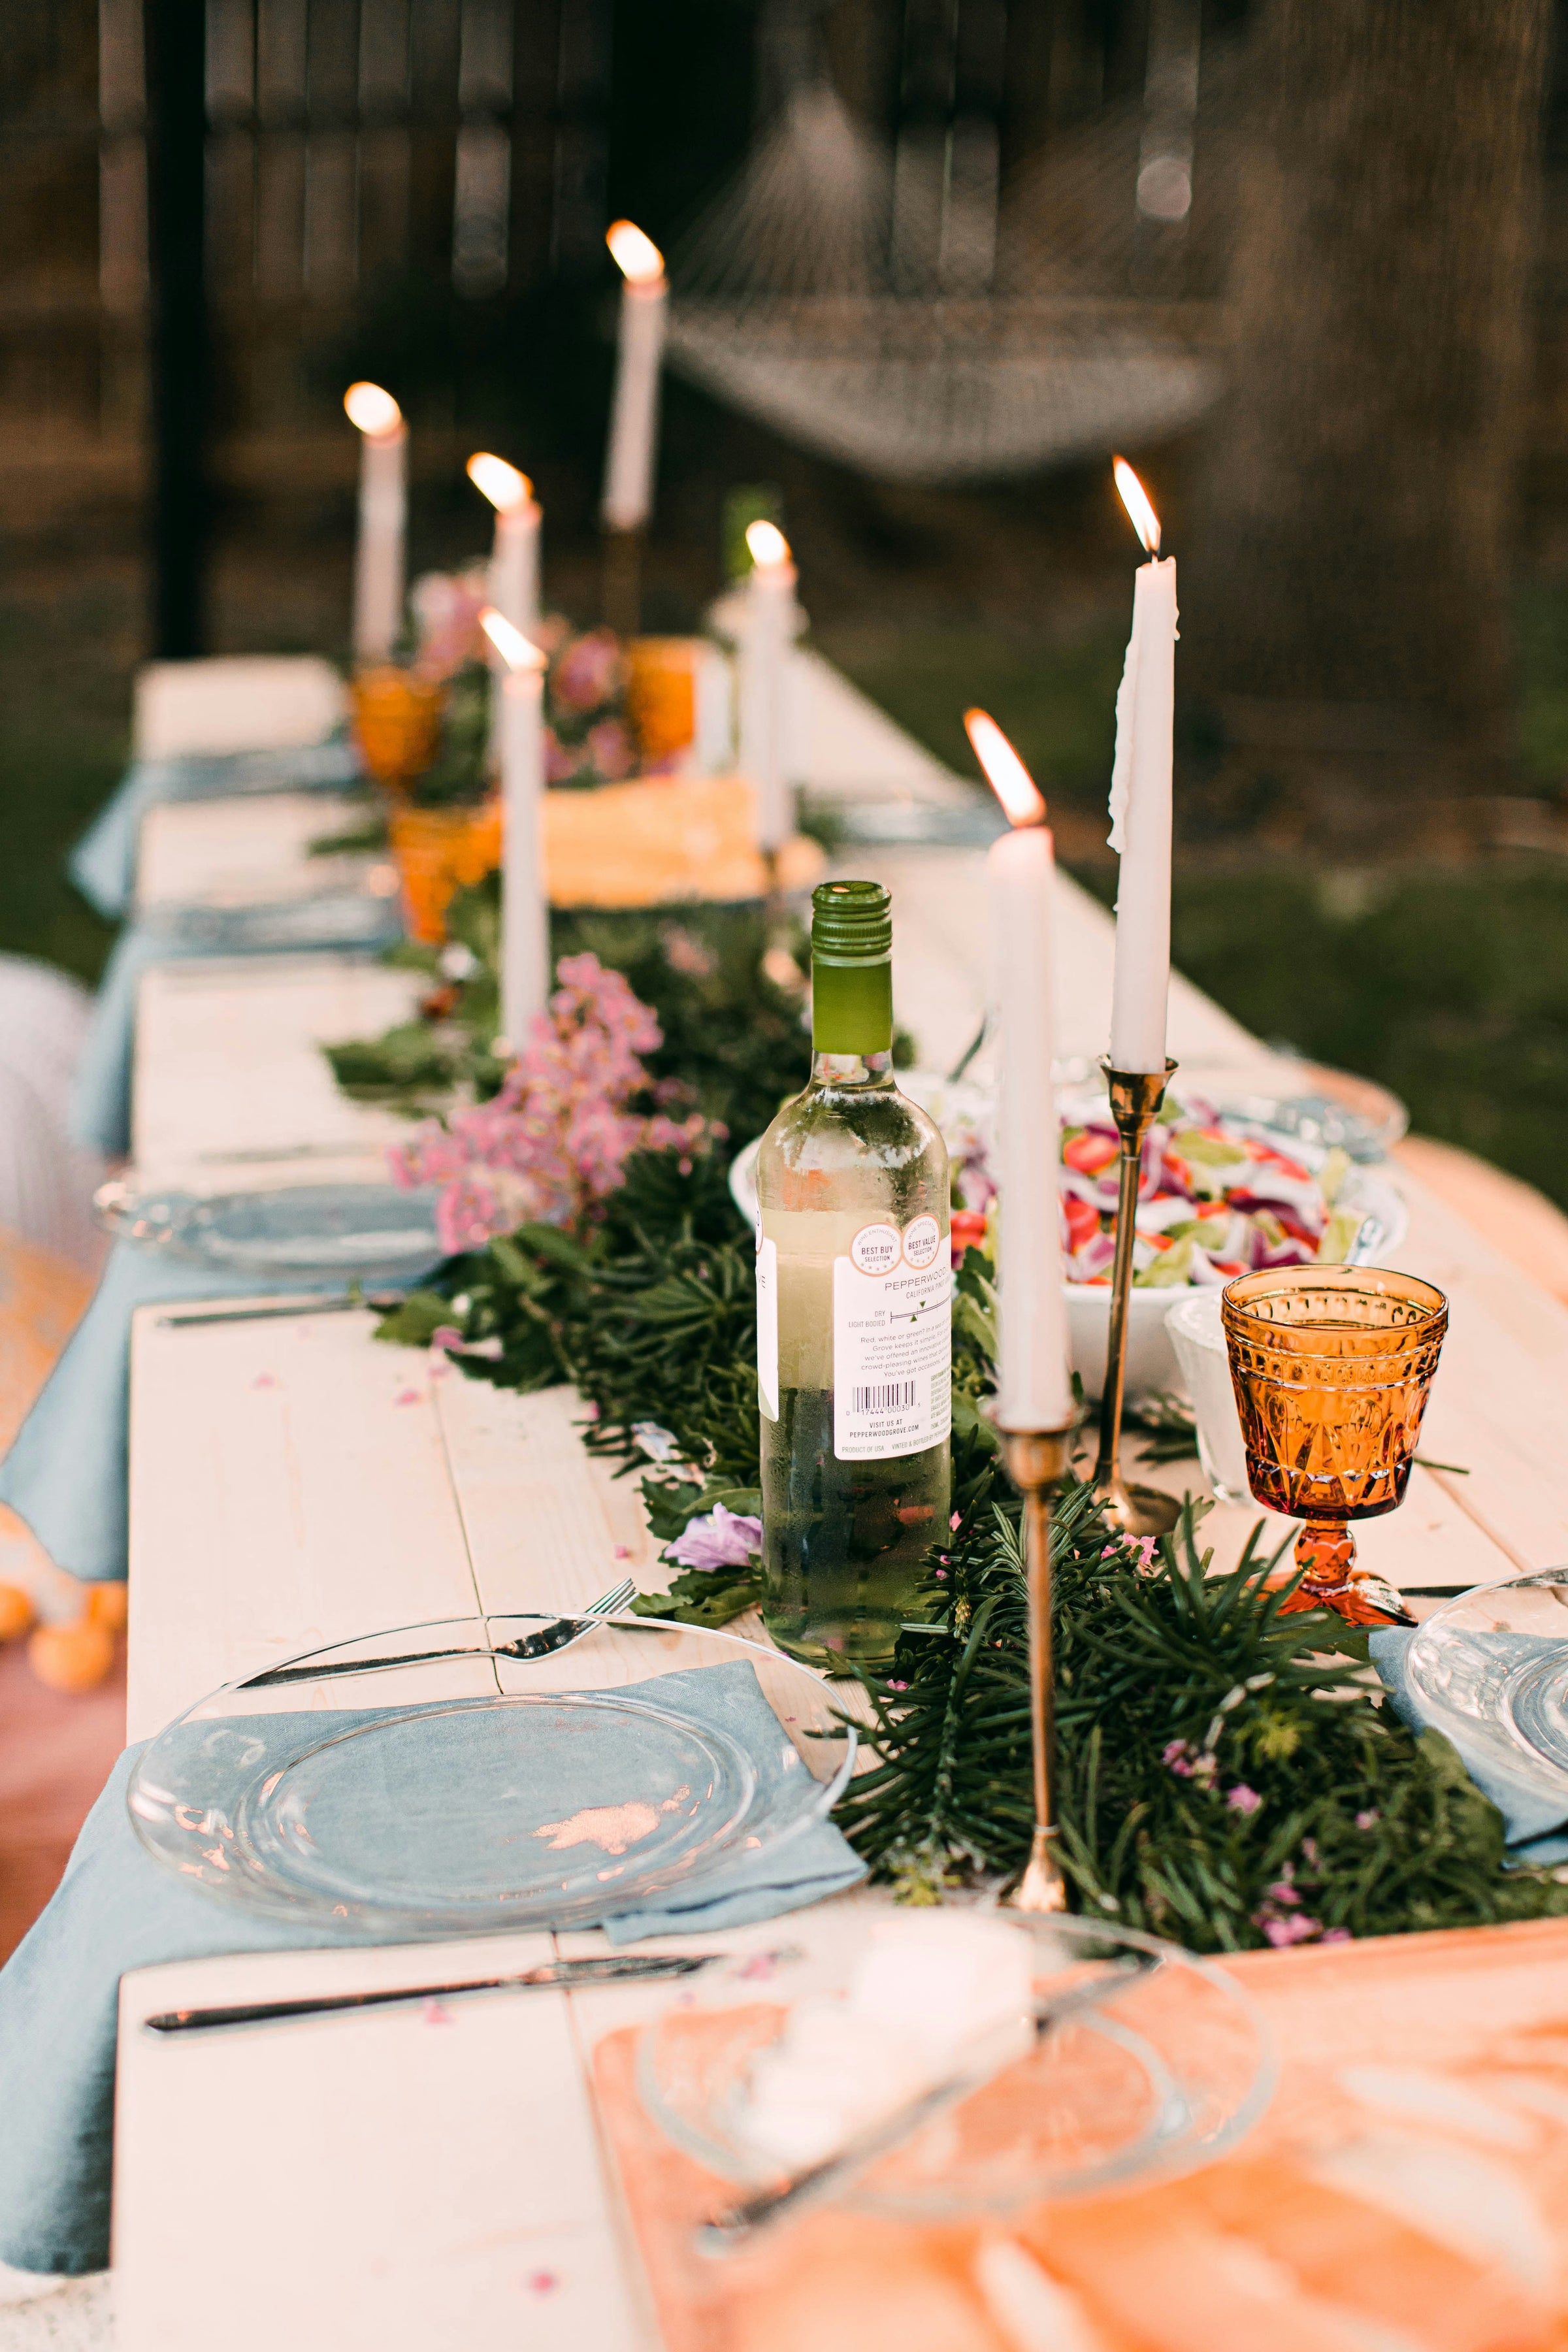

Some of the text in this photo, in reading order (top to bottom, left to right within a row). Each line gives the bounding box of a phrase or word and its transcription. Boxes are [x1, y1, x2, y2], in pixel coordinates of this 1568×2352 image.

[857, 1229, 897, 1246] WINE ENTHUSIAST
[908, 1228, 917, 1239] WINE
[909, 1235, 936, 1250] BEST VALUE
[881, 1245, 893, 1254] BUY
[913, 1247, 932, 1256] SELECTION
[906, 1286, 934, 1299] CALIFORNIA
[907, 1328, 925, 1339] green?
[887, 1351, 909, 1360] offered
[861, 1360, 911, 1371] crowd-pleasing
[888, 1403, 910, 1414] 00030
[850, 1424, 919, 1438] PEPPERWOODGROVE.COM
[913, 1437, 928, 1446] BOTTLED
